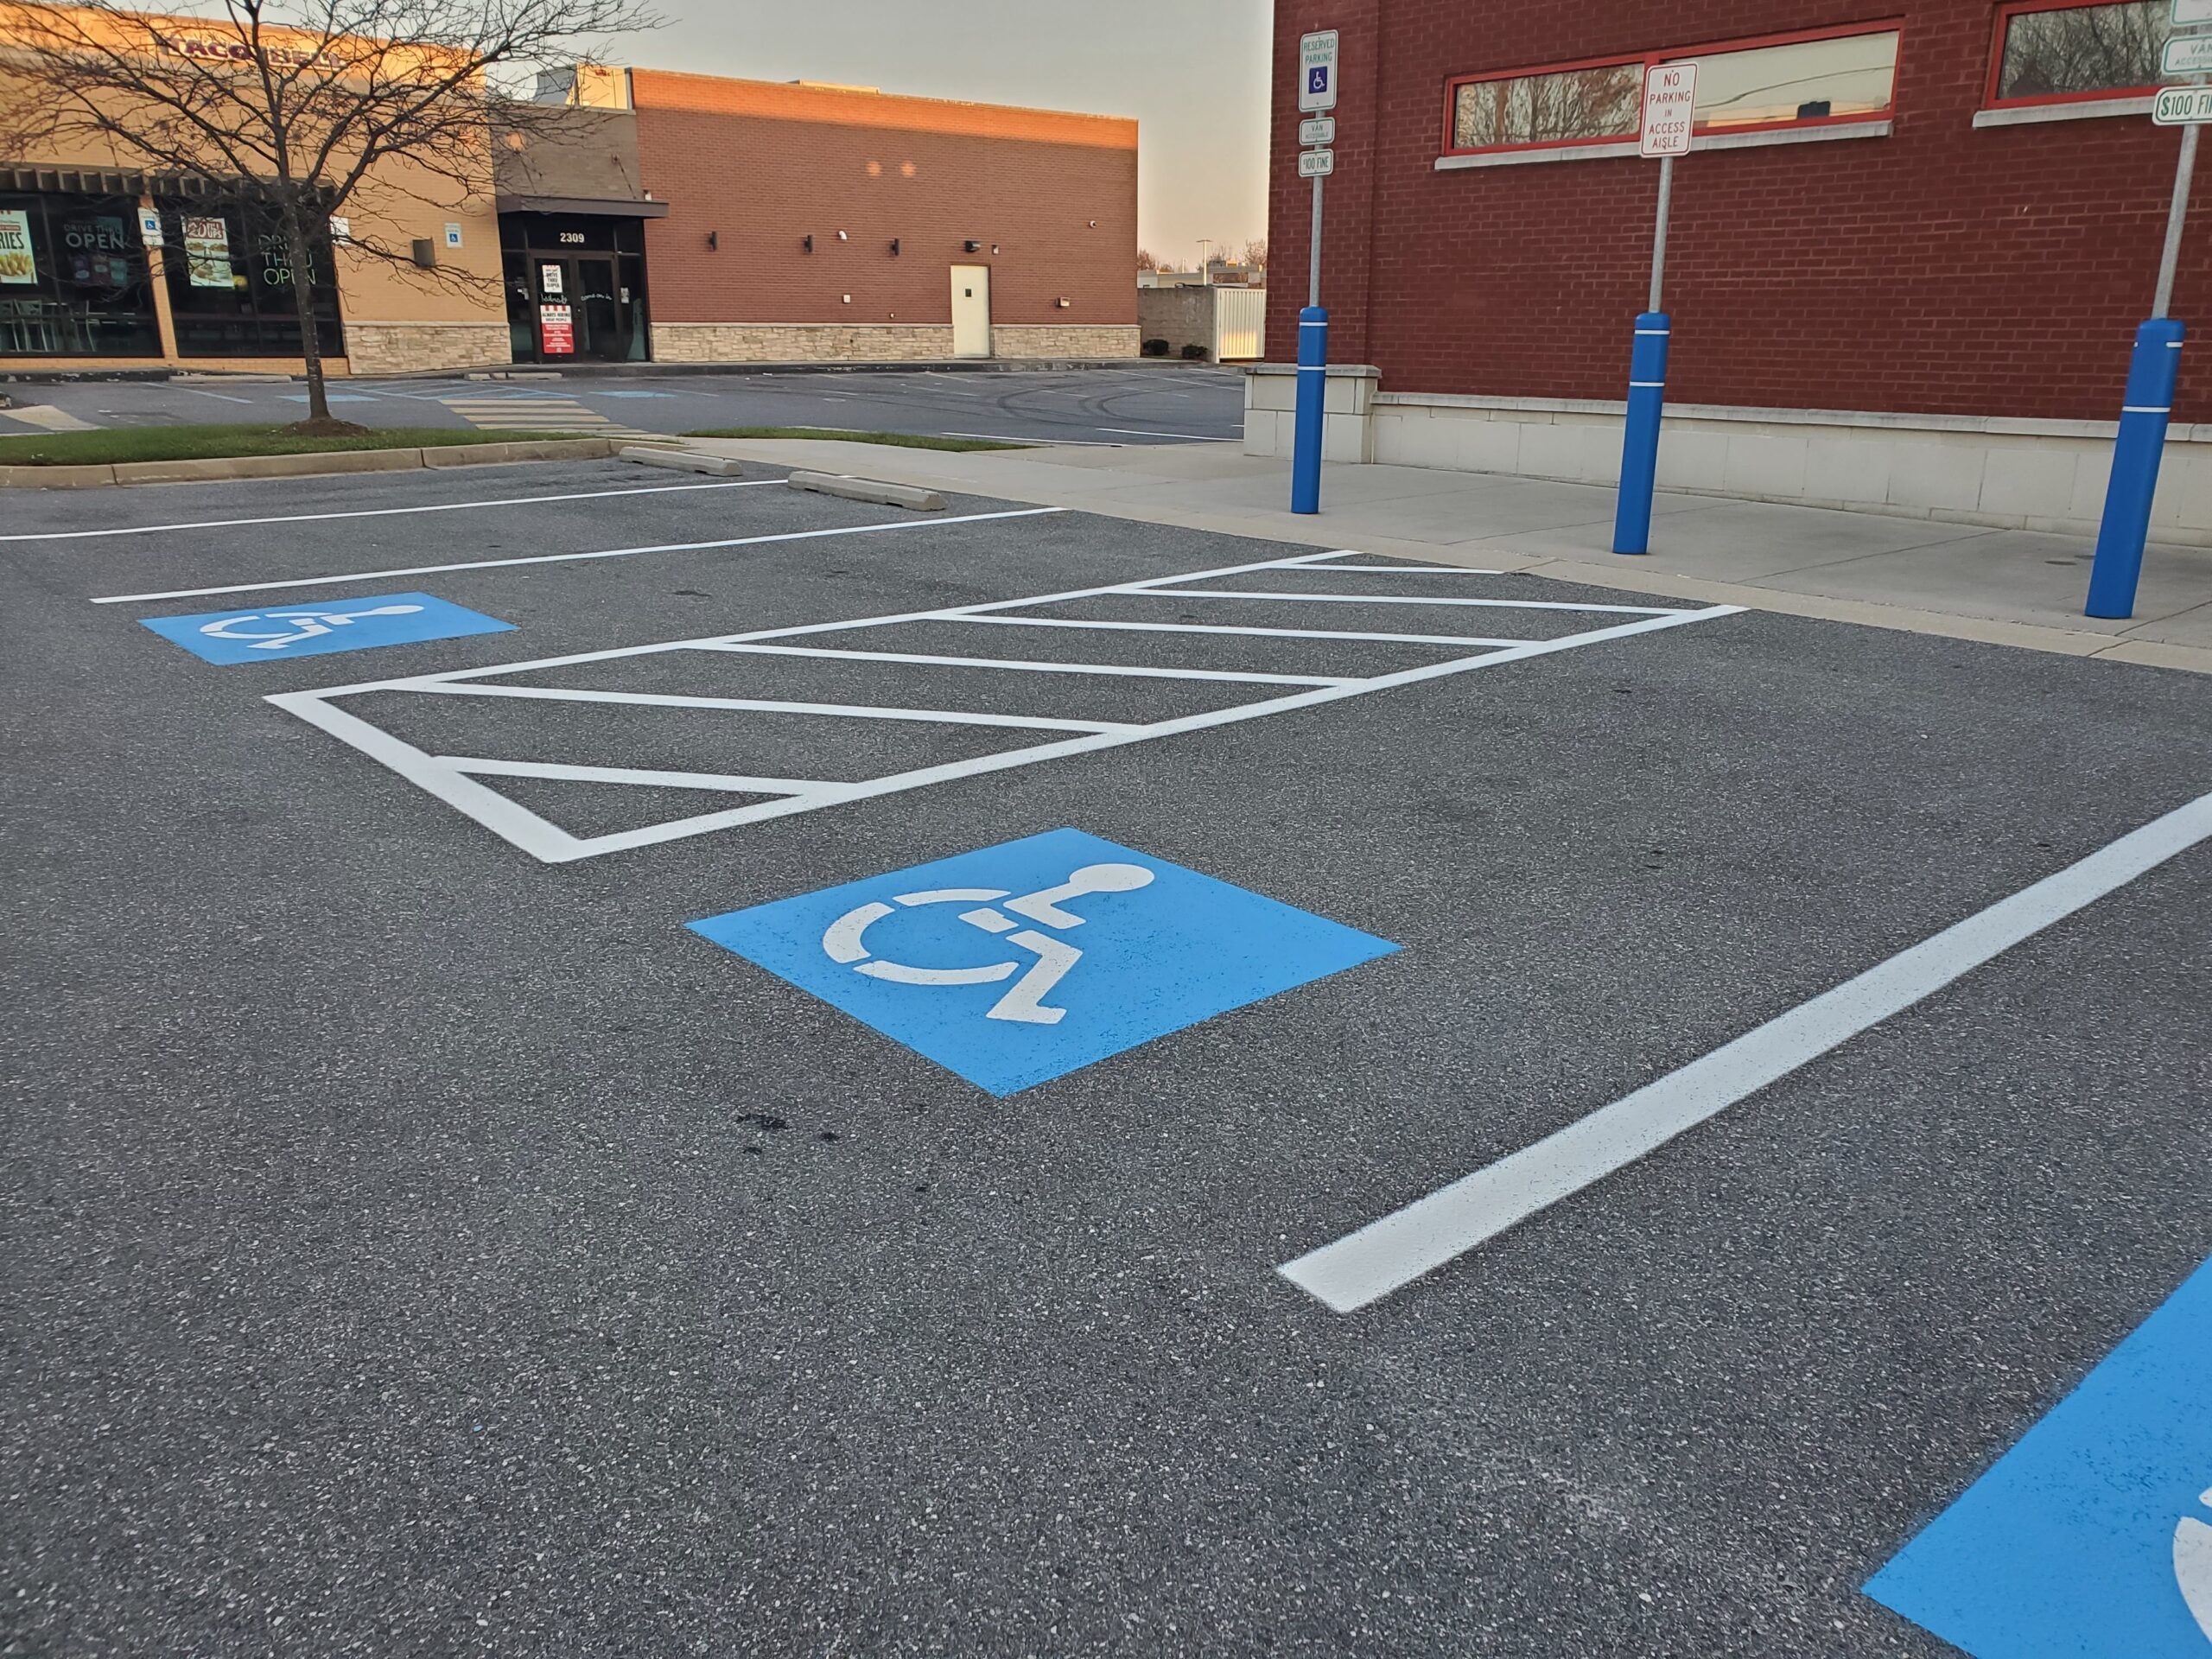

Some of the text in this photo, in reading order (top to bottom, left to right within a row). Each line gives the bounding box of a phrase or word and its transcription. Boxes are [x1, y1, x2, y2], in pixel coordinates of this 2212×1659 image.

[164, 36, 343, 68] TACO BELL
[1303, 38, 1335, 52] RESERVED
[1305, 52, 1332, 65] PARKING
[1663, 72, 1680, 87] NO
[1649, 91, 1691, 105] PARKING
[2161, 95, 2193, 117] $100
[1664, 109, 1672, 118] IN
[1649, 121, 1685, 135] ACCESS
[1652, 136, 1679, 149] AISLE
[1317, 156, 1329, 168] FINE
[66, 232, 125, 249] OPEN
[560, 232, 585, 243] 2309
